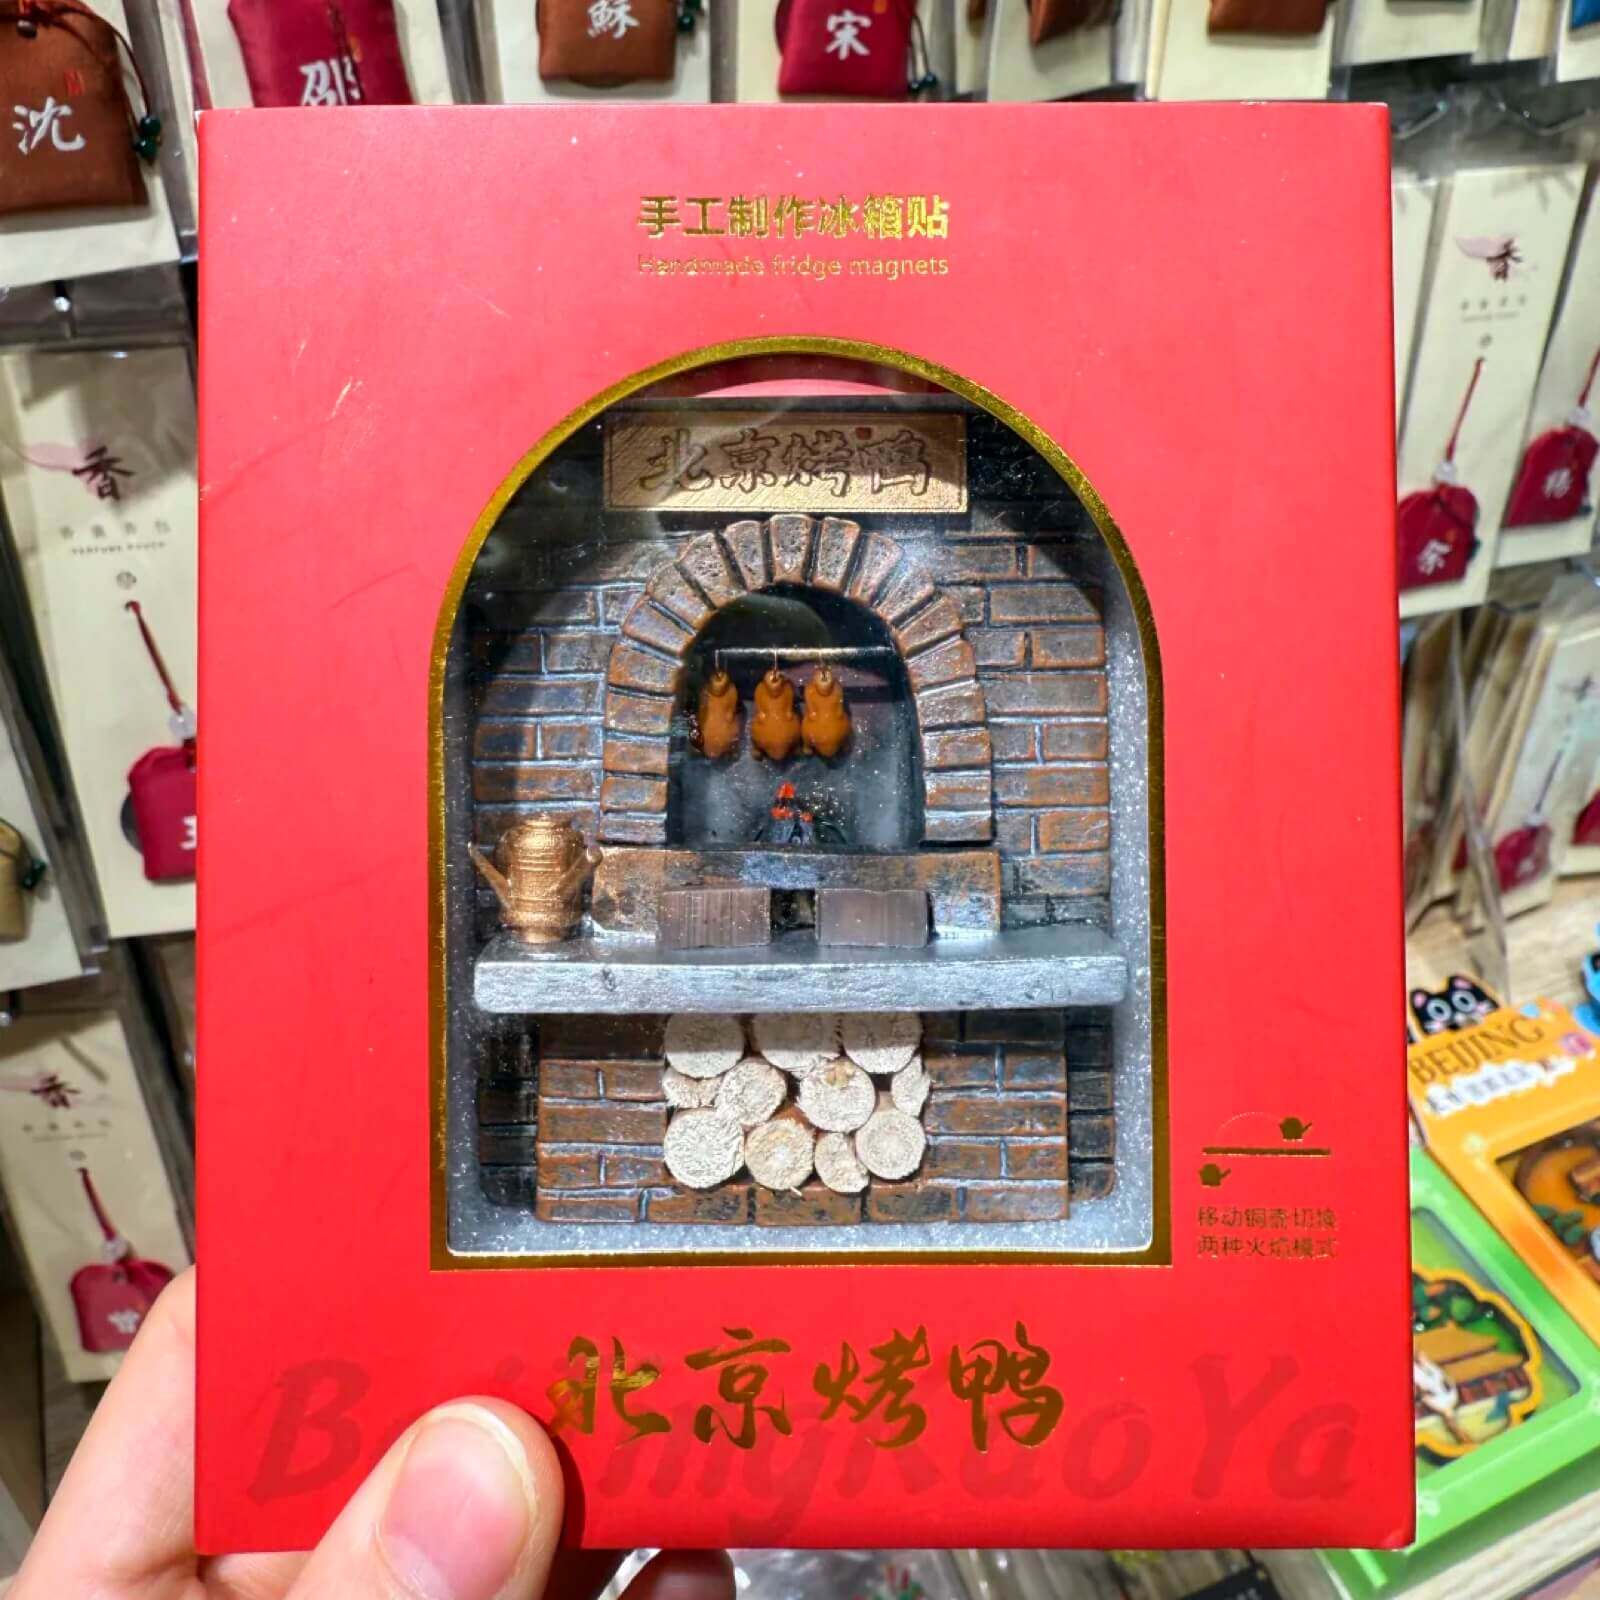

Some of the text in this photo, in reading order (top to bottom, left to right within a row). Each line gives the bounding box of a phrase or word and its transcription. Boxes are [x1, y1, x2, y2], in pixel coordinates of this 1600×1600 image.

[825, 10, 871, 60] 宋
[12, 97, 85, 155] 沈
[638, 195, 950, 239] 手工制作冰箱贴
[638, 254, 949, 281] Handmade fridge magnets
[640, 427, 934, 498] 北京烤鸭
[1408, 1017, 1546, 1086] BEIJING
[546, 1321, 1064, 1452] 北京烤鸭
